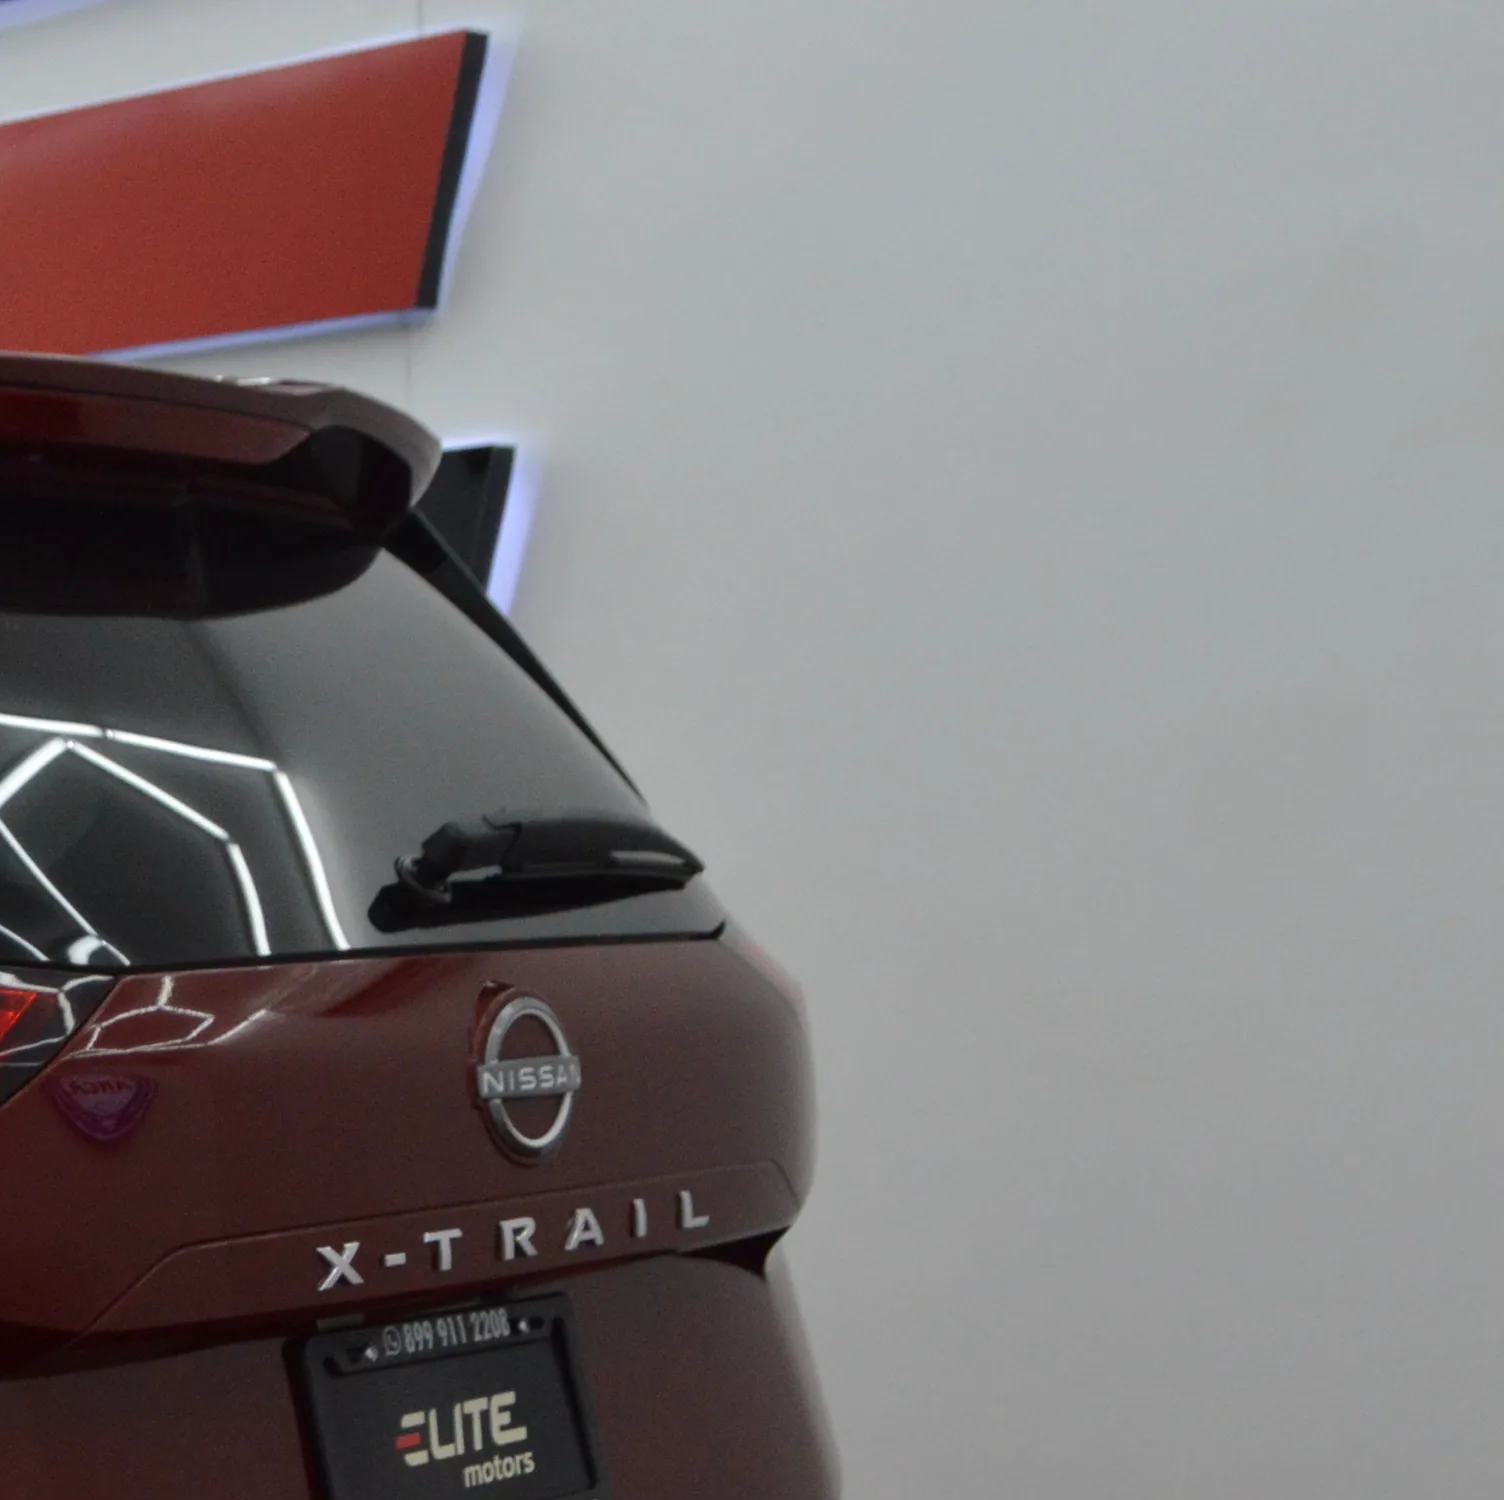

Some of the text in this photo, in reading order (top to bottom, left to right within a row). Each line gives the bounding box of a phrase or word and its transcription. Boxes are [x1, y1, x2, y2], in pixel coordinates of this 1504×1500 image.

[481, 1063, 580, 1094] NISSAN
[316, 1190, 710, 1291] X-TRAIL
[403, 1320, 434, 1353] 899
[435, 1314, 468, 1347] 911
[395, 1390, 527, 1467] ELITE
[463, 1451, 536, 1489] motors
